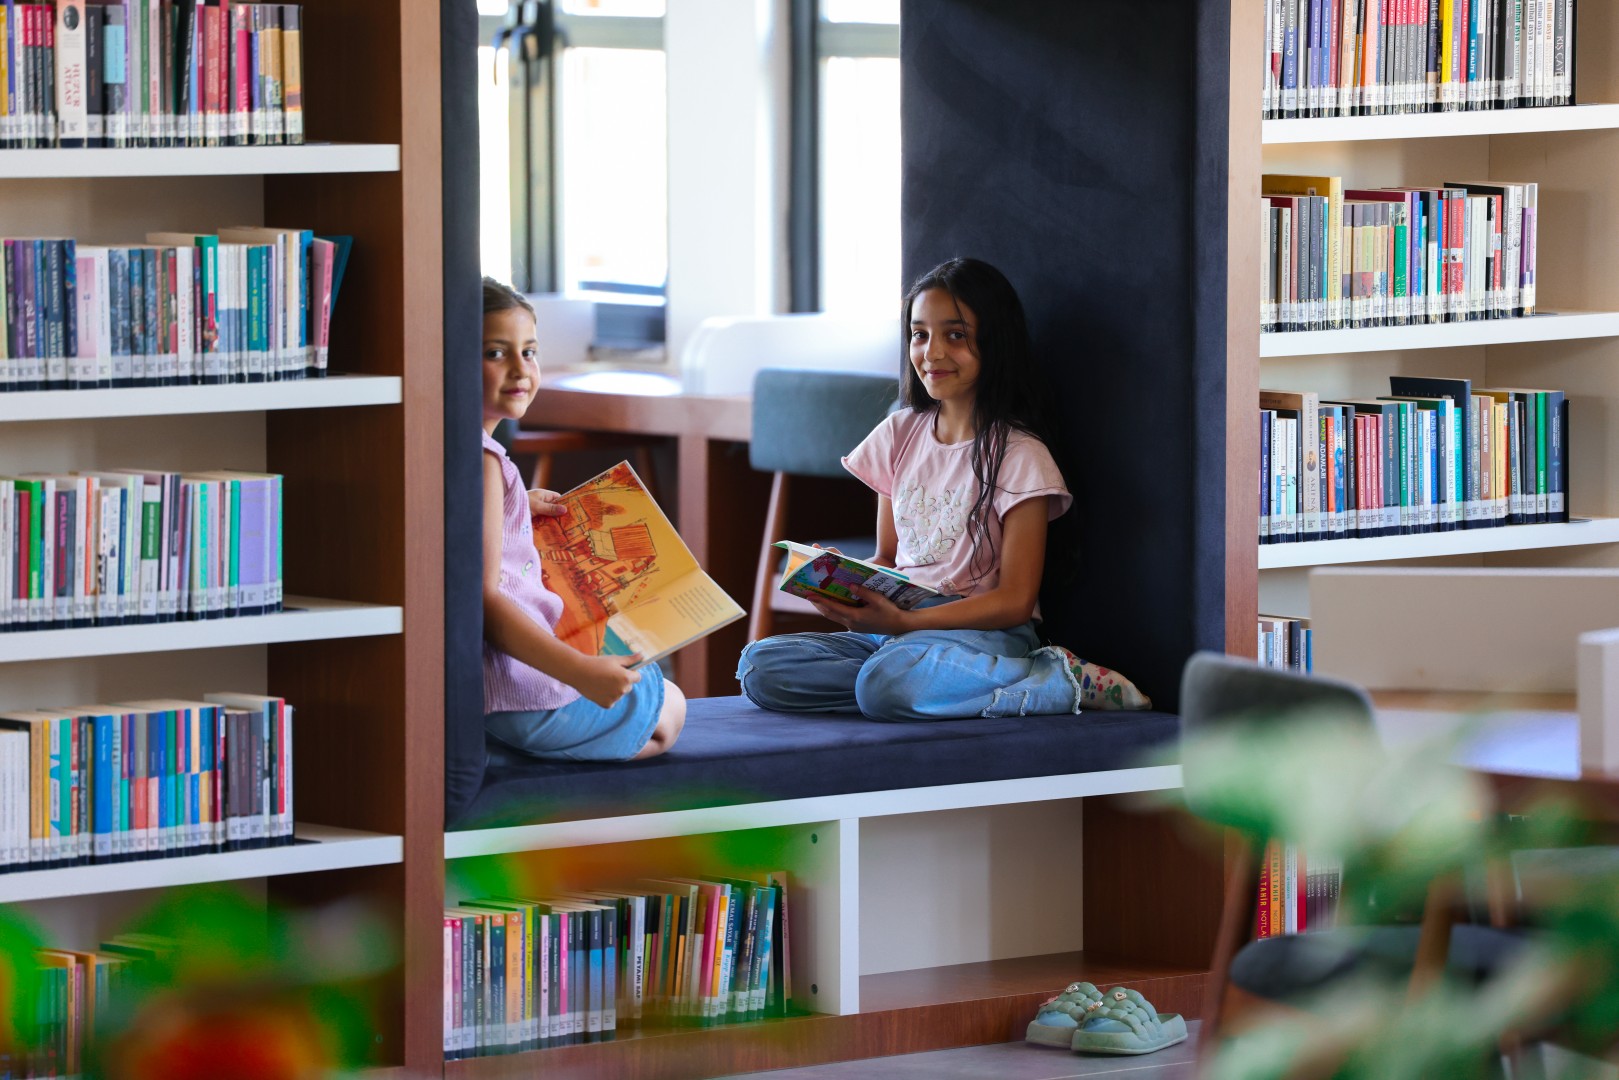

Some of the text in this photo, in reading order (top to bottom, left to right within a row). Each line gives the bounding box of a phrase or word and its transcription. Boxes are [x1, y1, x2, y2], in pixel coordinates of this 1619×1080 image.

[1555, 36, 1564, 51] KIŞ
[1555, 52, 1564, 72] ÇAY
[64, 67, 72, 106] ATLASI
[72, 63, 80, 108] HUZUR
[50, 243, 58, 269] NAZAN
[24, 298, 35, 317] yol
[1260, 881, 1268, 906] TAHİR
[728, 899, 736, 922] KEMAL
